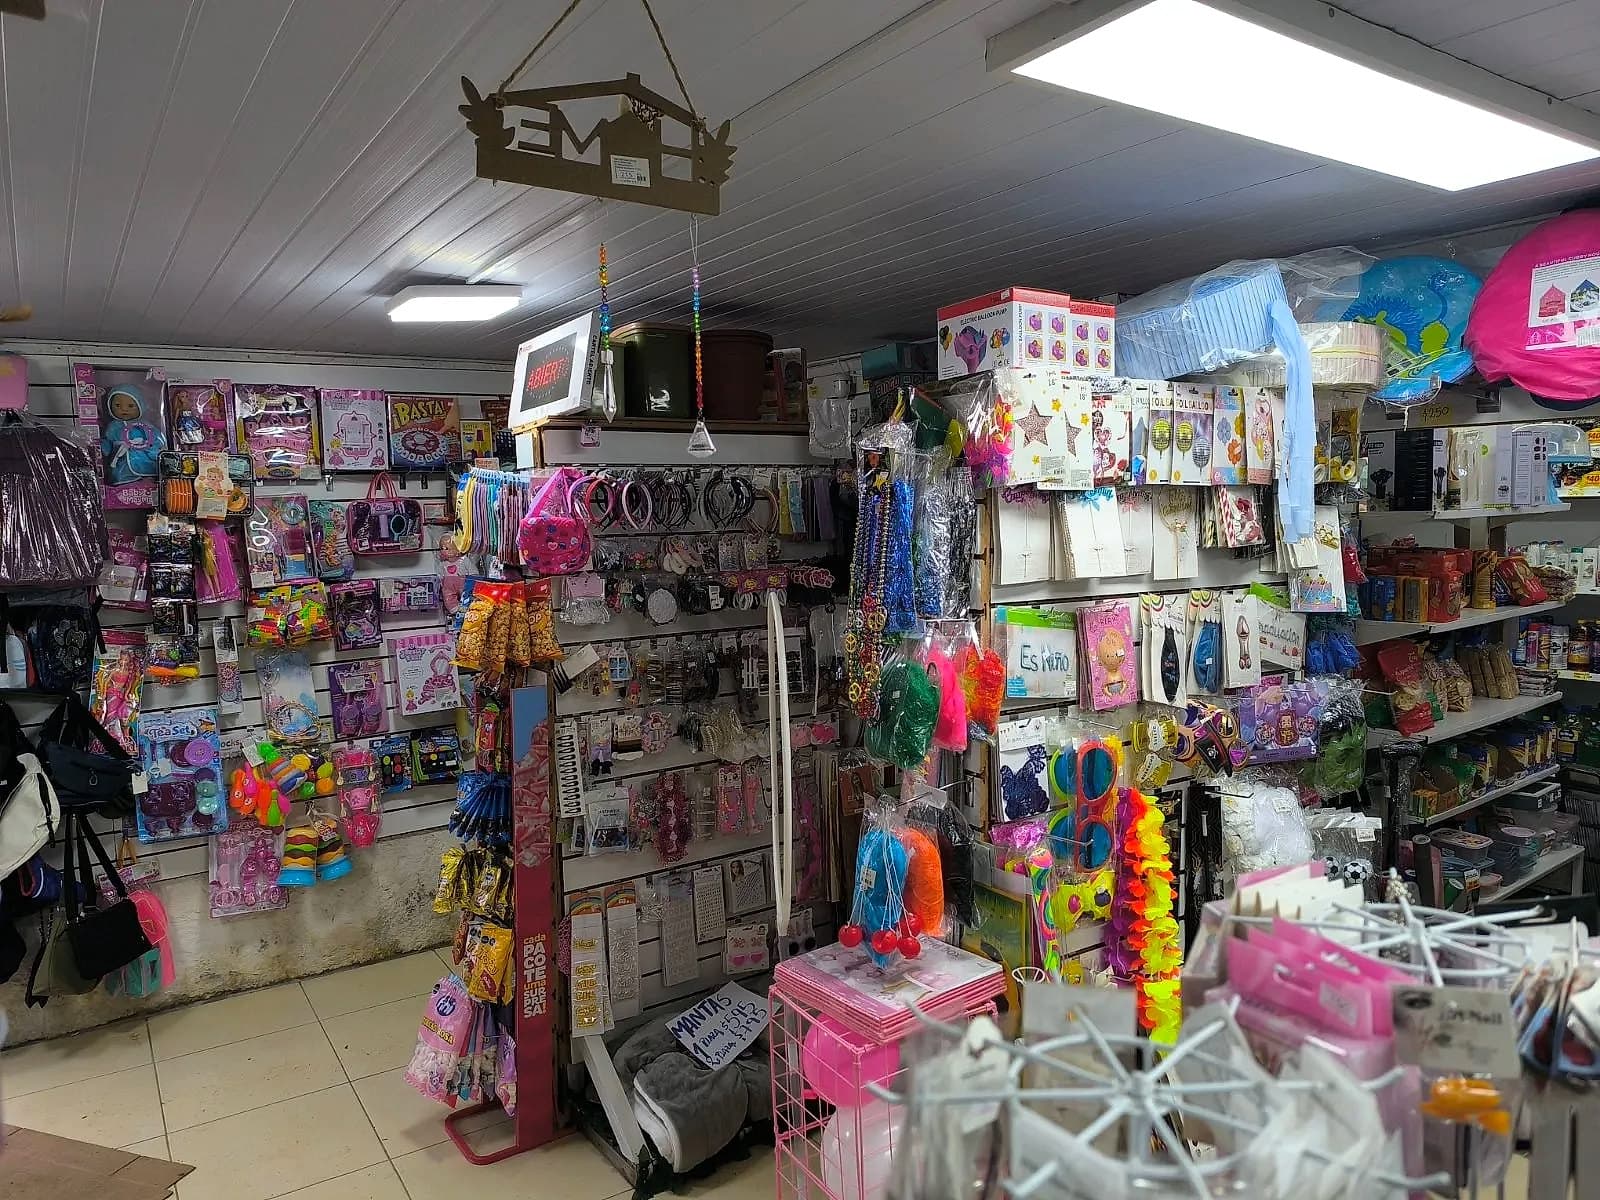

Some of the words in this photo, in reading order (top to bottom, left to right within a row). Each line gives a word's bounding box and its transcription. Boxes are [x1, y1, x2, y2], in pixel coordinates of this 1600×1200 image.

[977, 310, 996, 321] BALLOON
[1020, 645, 1039, 672] Es
[150, 726, 171, 739] Tea
[171, 725, 191, 736] Set
[221, 739, 240, 748] ocks
[523, 933, 546, 945] cada
[523, 942, 547, 957] PA
[523, 955, 547, 969] CO
[523, 967, 547, 983] TE
[523, 980, 547, 991] uma
[523, 987, 547, 999] SUR
[523, 996, 547, 1007] PRE
[523, 1002, 547, 1019] SA!
[670, 993, 732, 1039] MANTAS
